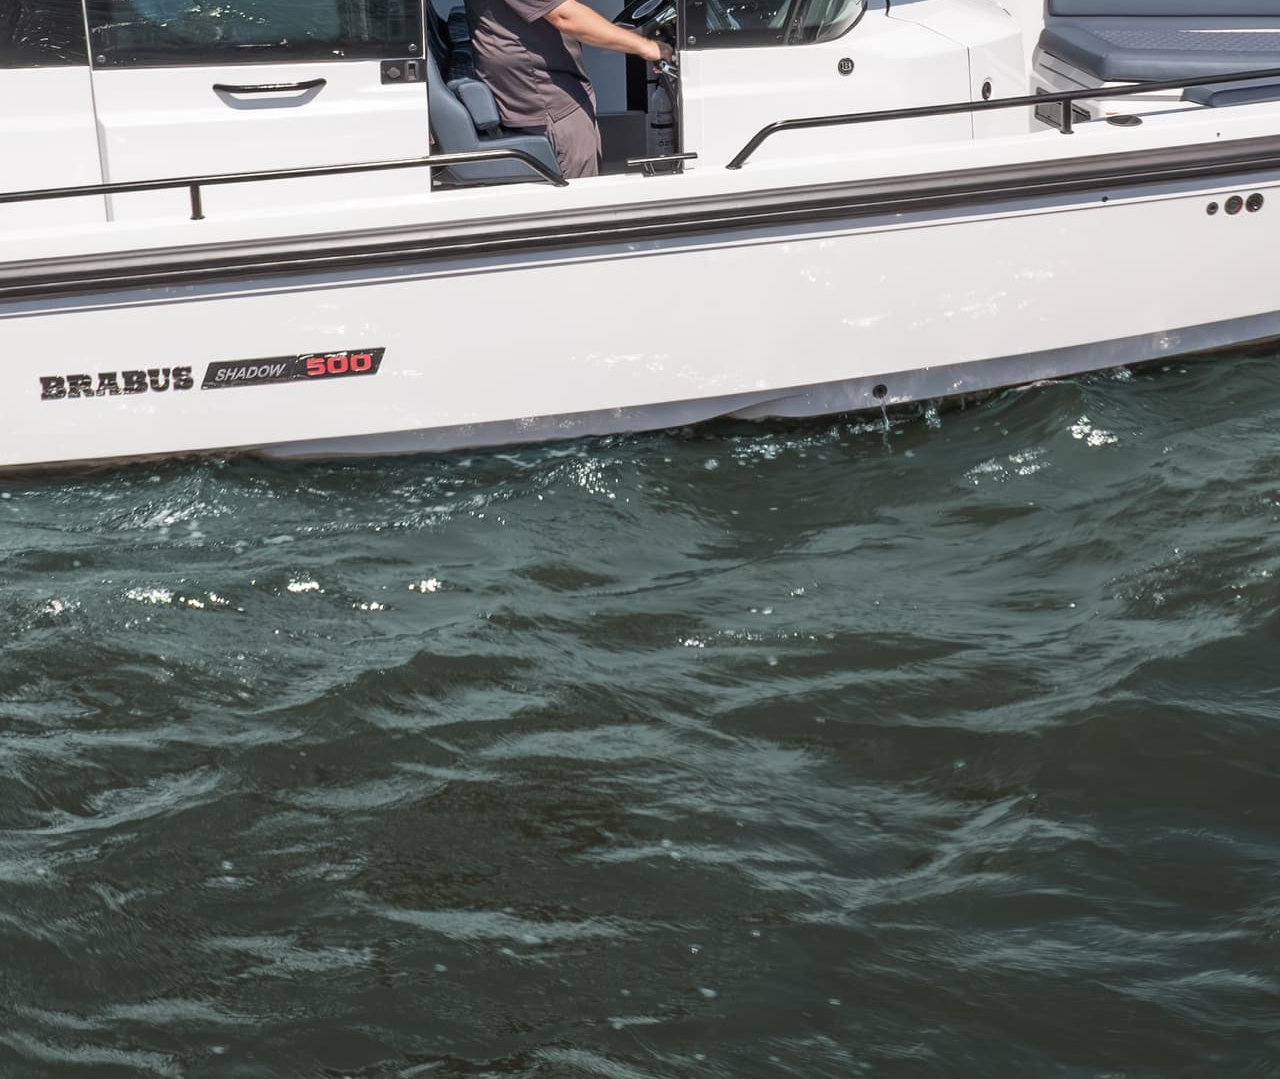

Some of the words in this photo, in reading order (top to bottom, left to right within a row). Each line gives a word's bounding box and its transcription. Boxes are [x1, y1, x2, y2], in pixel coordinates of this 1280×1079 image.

[39, 366, 194, 401] BRABUS
[215, 363, 287, 381] SHADOW
[306, 353, 372, 376] 500
